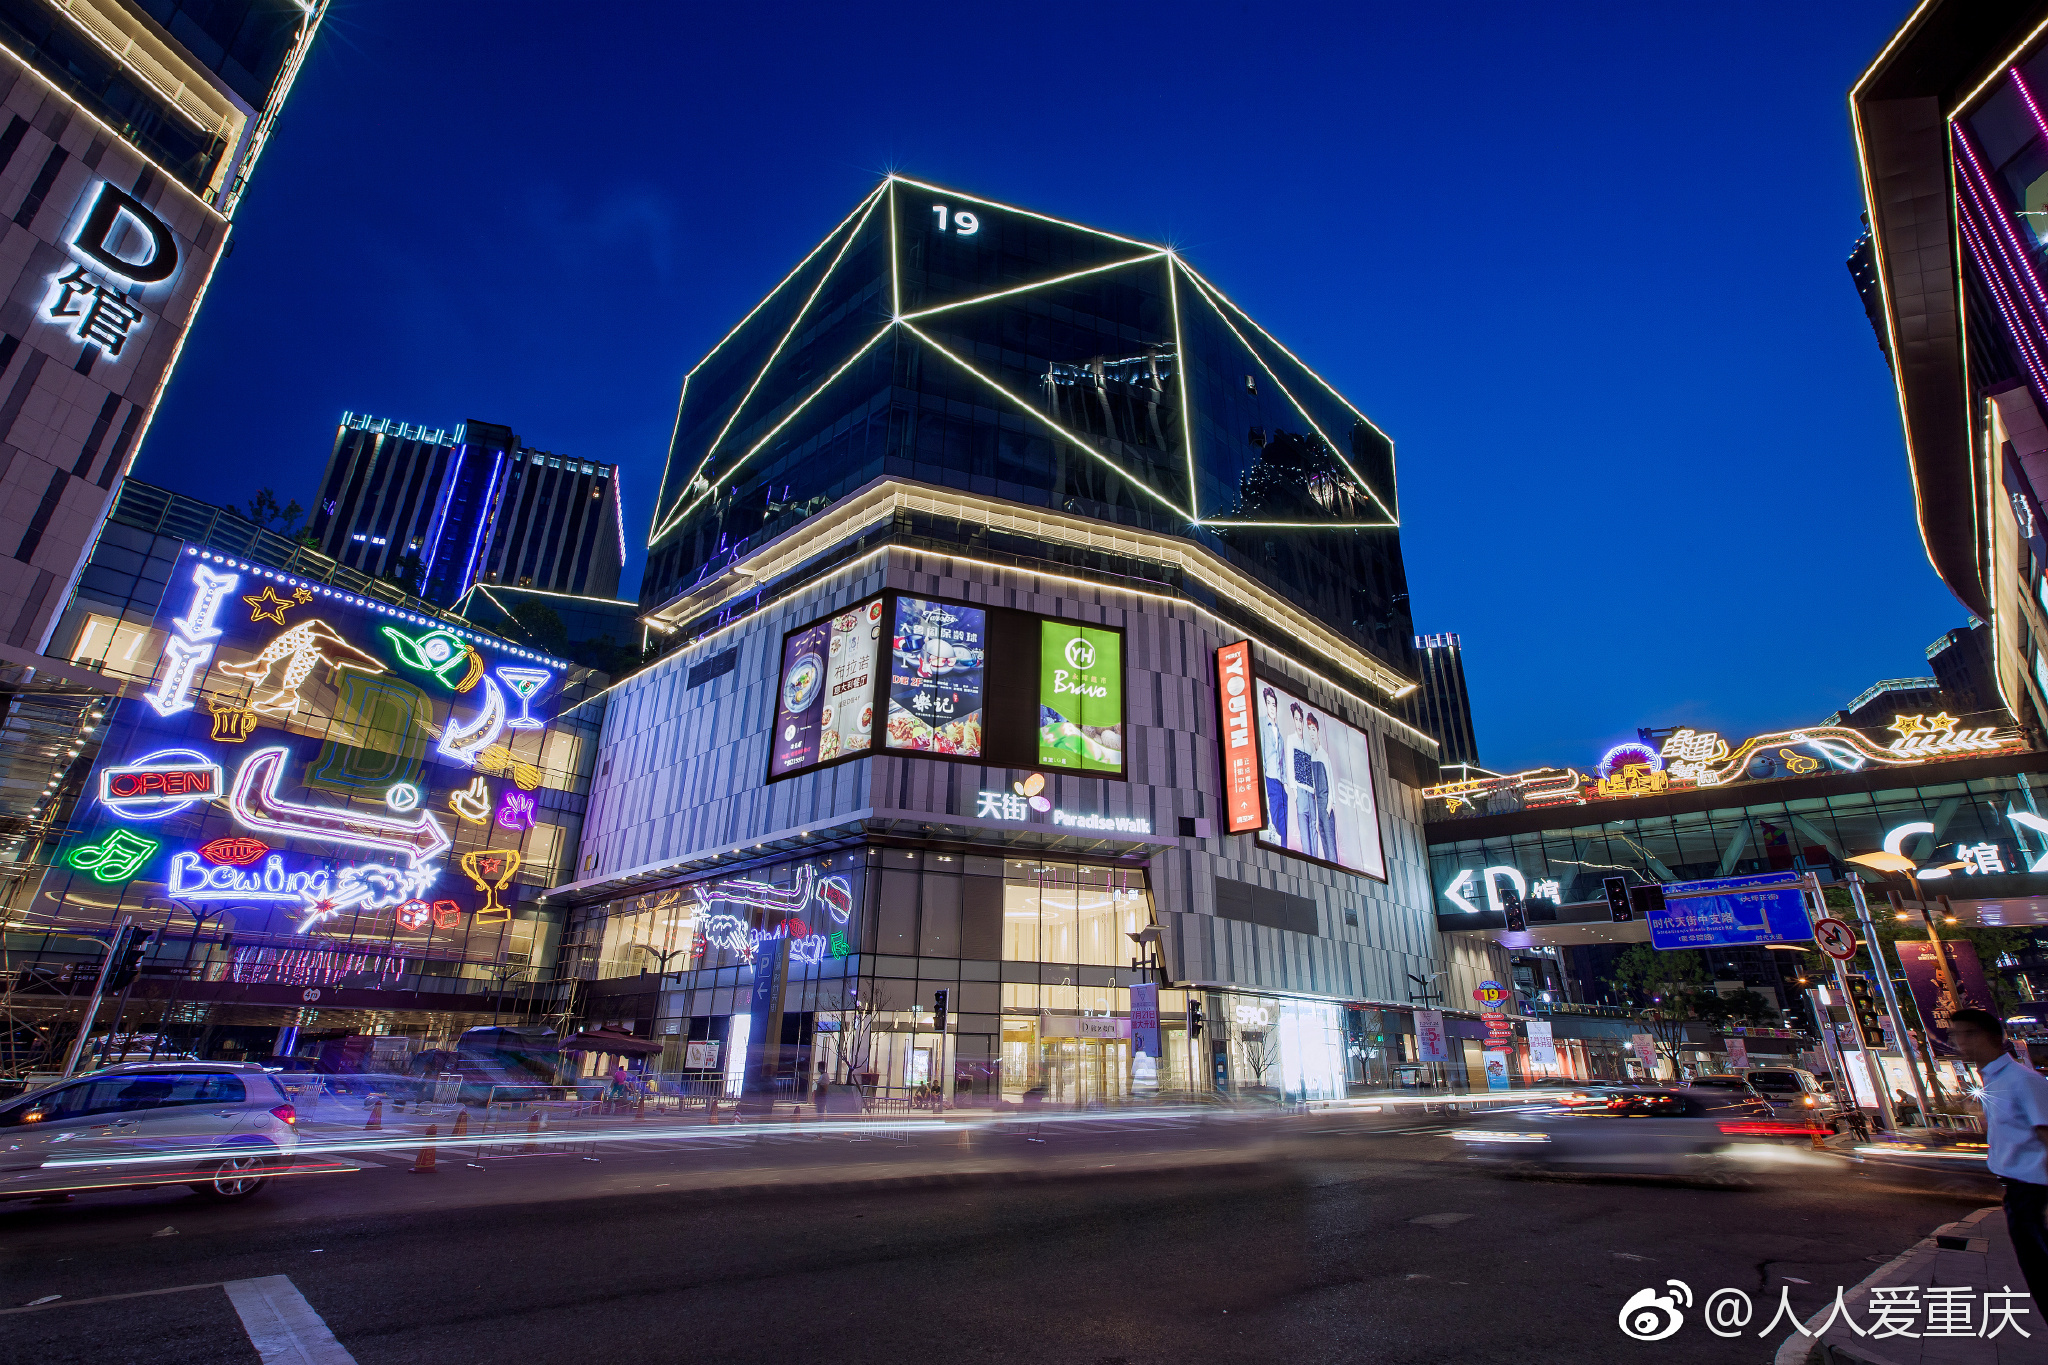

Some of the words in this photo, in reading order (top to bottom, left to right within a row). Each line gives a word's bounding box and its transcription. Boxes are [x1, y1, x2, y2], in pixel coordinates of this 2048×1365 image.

[69, 180, 179, 284] D
[932, 205, 980, 236] 19
[48, 263, 144, 357] 馆
[1053, 669, 1108, 698] Bravo
[1226, 656, 1249, 749] YOUTH
[110, 771, 210, 797] OPEN
[1337, 781, 1372, 814] SPAO
[976, 791, 1028, 821] 天街
[1053, 809, 1115, 831] Paradise
[1115, 816, 1151, 834] Walk
[1884, 821, 1952, 880] C
[1956, 841, 2006, 876] 馆
[1484, 865, 1526, 911] D
[1652, 911, 1734, 929] 时代天街中支路
[760, 956, 770, 975] P
[1480, 988, 1500, 1002] 19
[1235, 1004, 1269, 1026] SPAO
